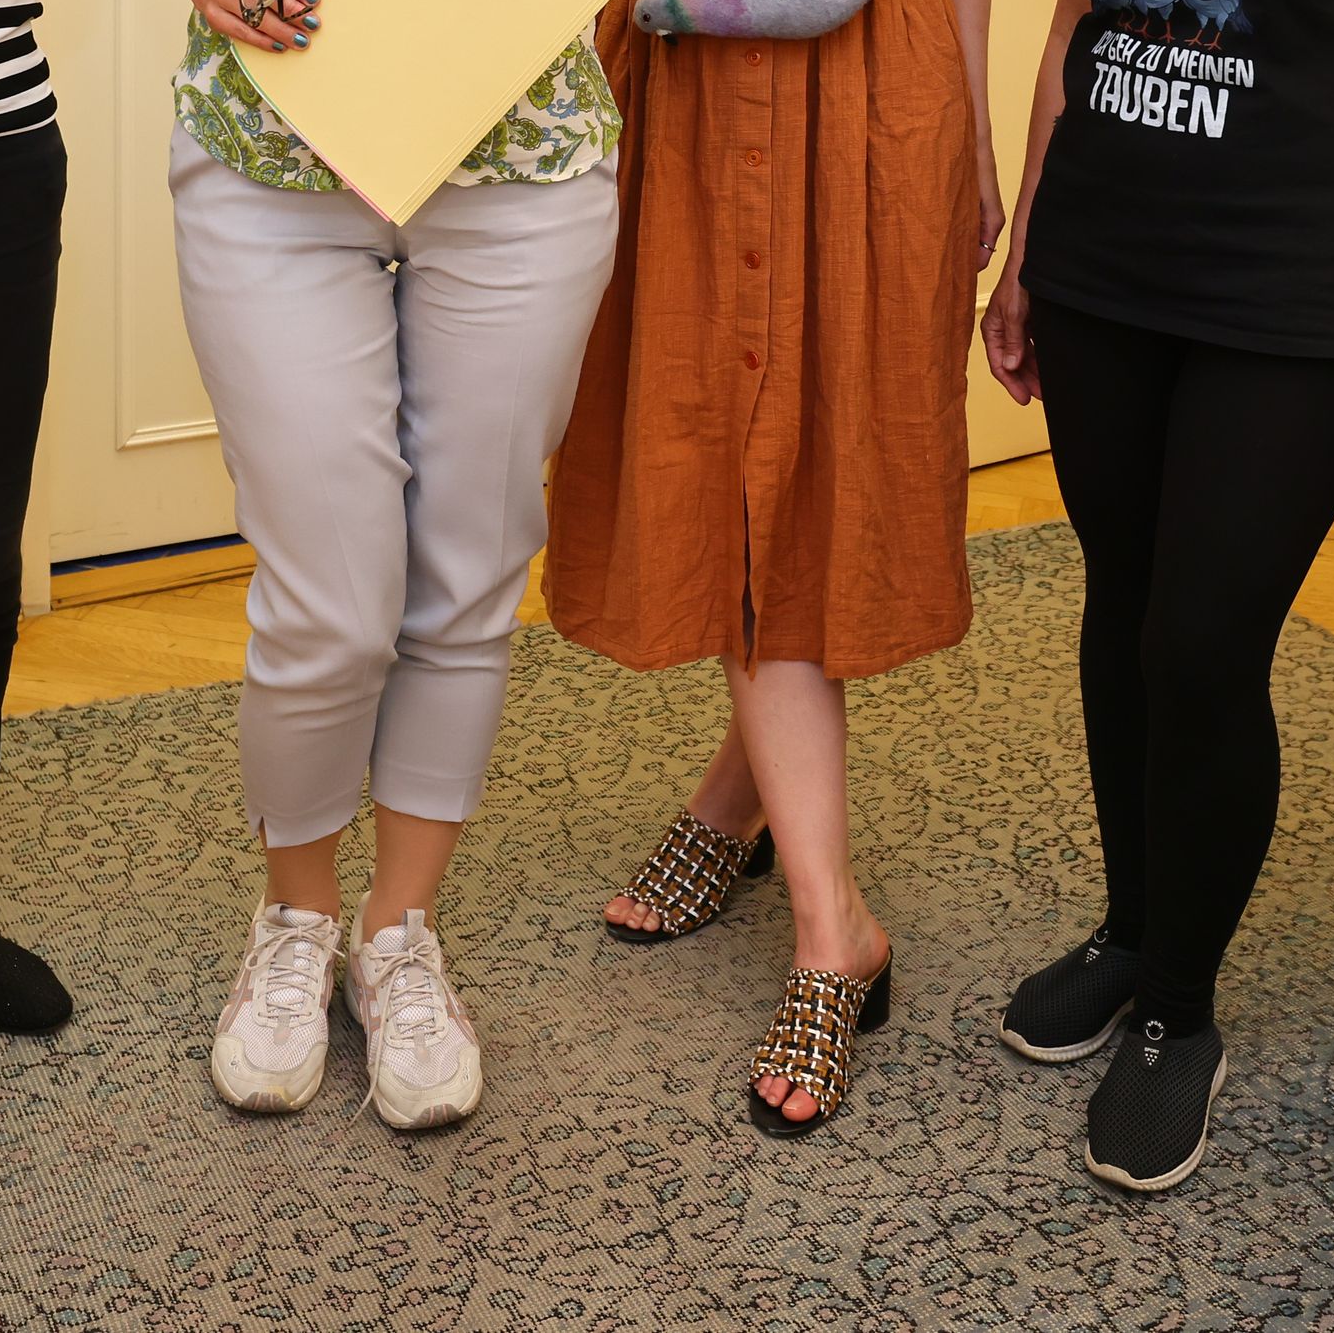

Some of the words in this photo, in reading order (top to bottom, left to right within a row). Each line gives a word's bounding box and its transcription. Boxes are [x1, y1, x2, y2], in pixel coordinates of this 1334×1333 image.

[1091, 30, 1117, 57] ICH
[1108, 33, 1142, 65] GEH
[1135, 44, 1166, 72] ZU
[1164, 46, 1254, 88] MEINEN
[1089, 61, 1229, 138] TAUBEN
